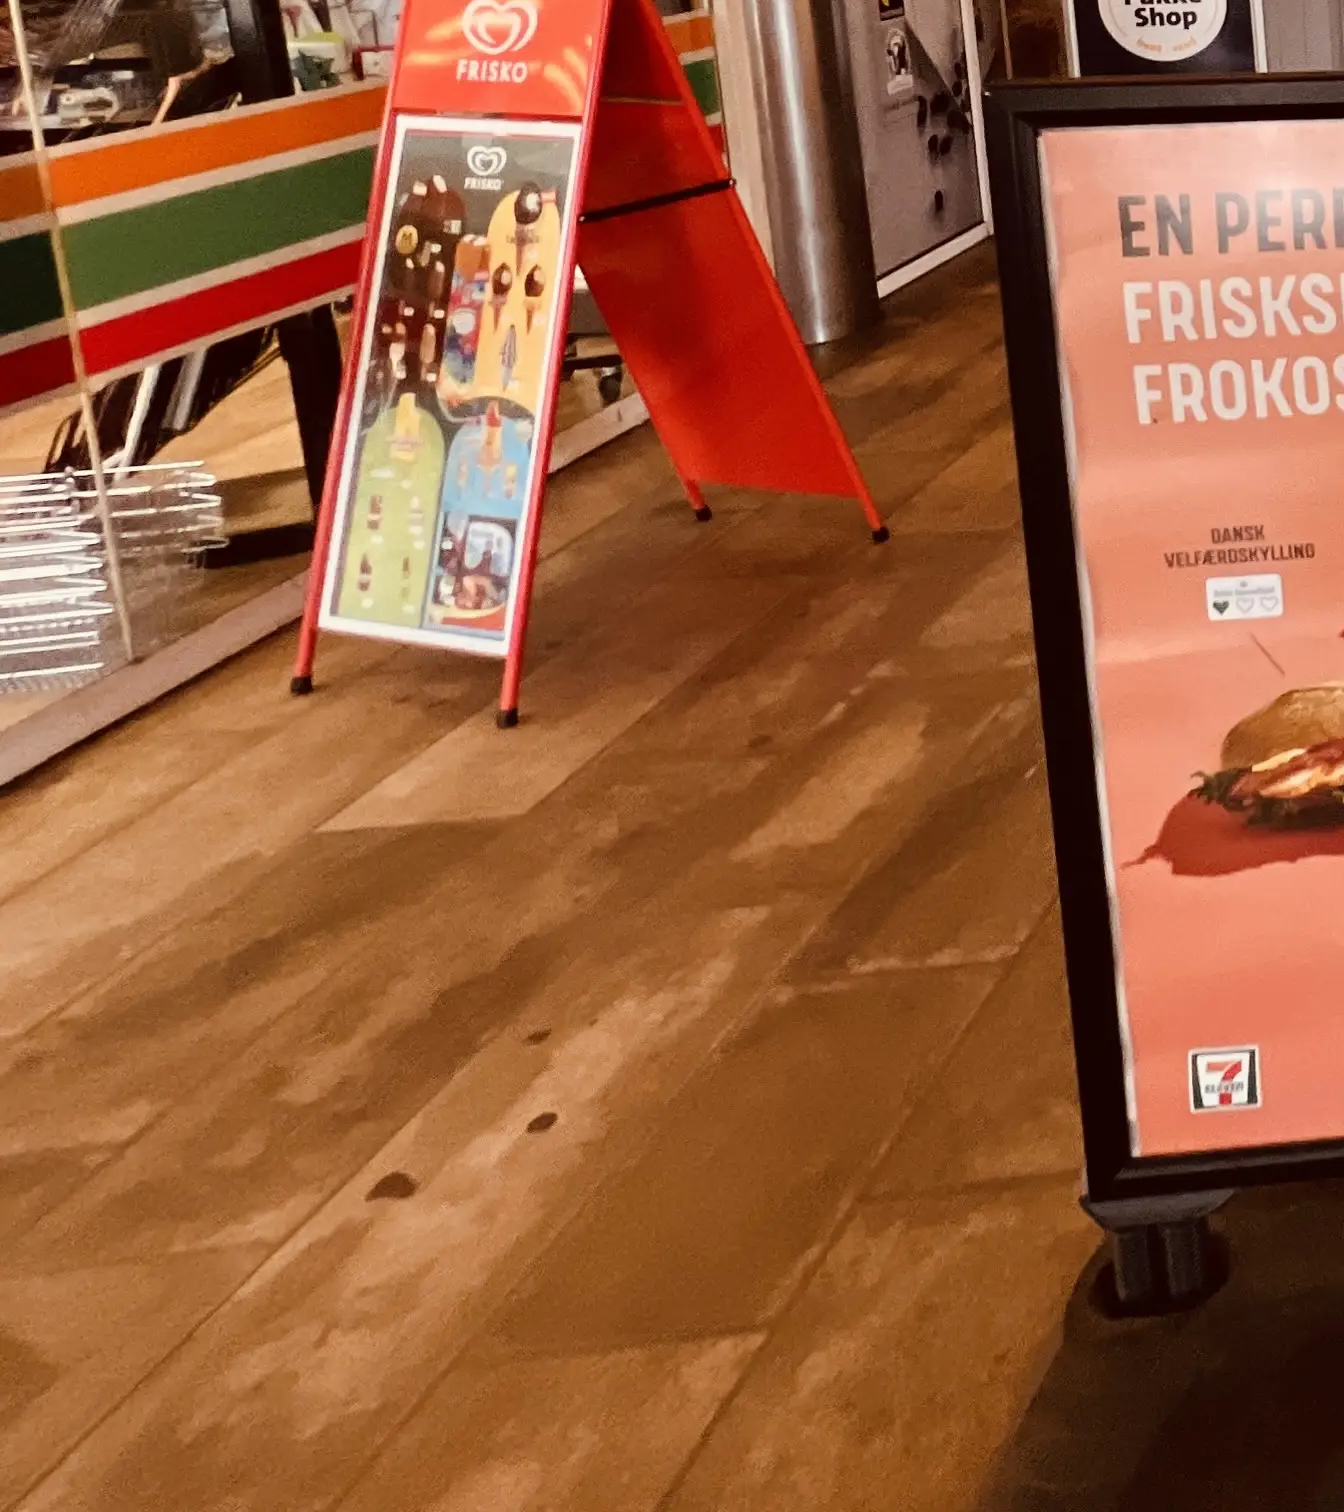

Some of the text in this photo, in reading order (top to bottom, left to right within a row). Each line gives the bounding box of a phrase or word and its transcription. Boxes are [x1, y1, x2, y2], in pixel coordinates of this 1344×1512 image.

[1134, 7, 1199, 30] Shop
[455, 58, 529, 85] FRISKO
[463, 176, 503, 191] FRISKO
[1117, 192, 1195, 258] EN
[1210, 524, 1266, 545] DANSK
[1164, 541, 1316, 569] VELFÆRDSKYLLING
